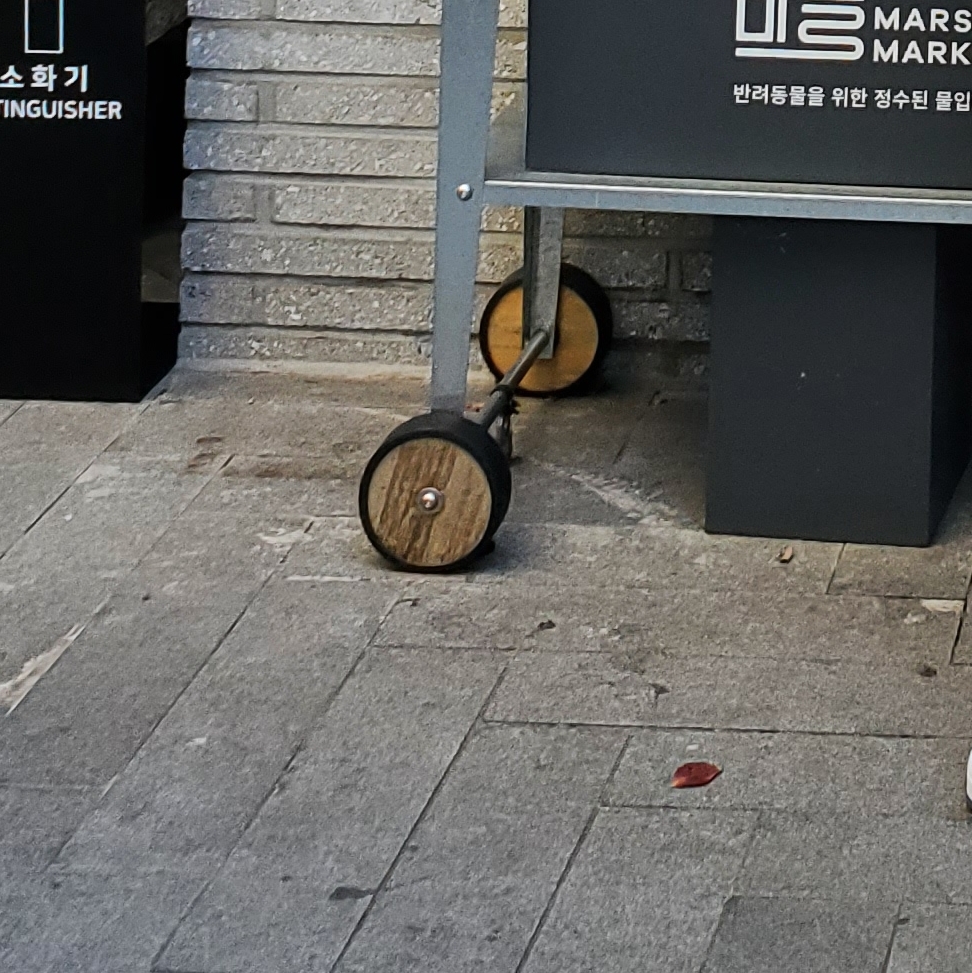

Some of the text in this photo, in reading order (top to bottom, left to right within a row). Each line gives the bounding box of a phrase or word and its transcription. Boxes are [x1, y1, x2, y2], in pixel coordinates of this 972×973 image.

[0, 64, 89, 94] 소화기
[733, 83, 826, 107] 반려동물을
[831, 86, 869, 109] 위한
[874, 88, 929, 110] 정수된
